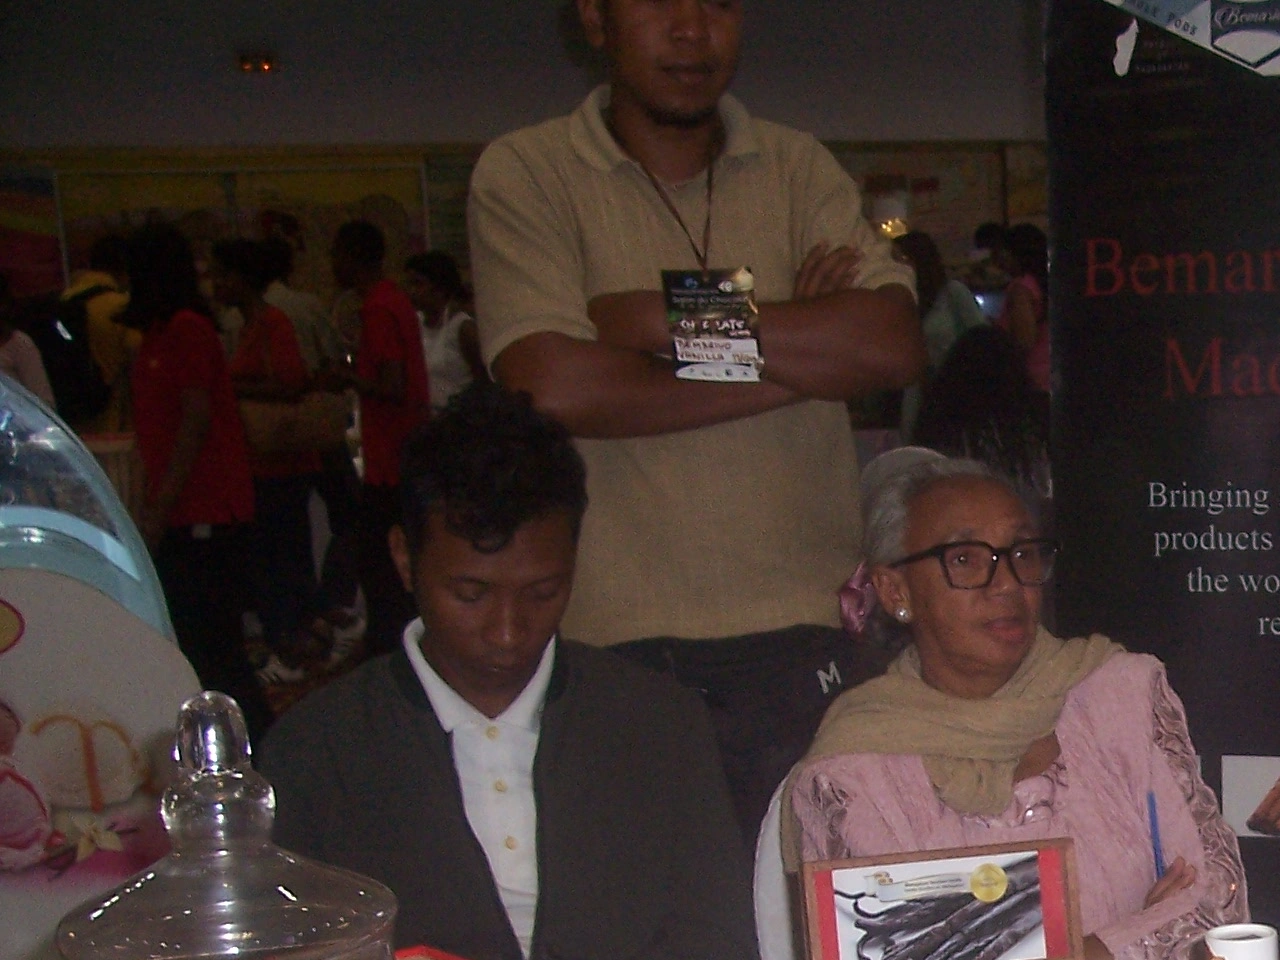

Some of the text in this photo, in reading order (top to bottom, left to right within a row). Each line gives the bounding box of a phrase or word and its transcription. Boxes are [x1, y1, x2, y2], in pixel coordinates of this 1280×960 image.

[1148, 481, 1269, 515] Bringing
[1154, 526, 1272, 556] products
[1187, 568, 1228, 593] the
